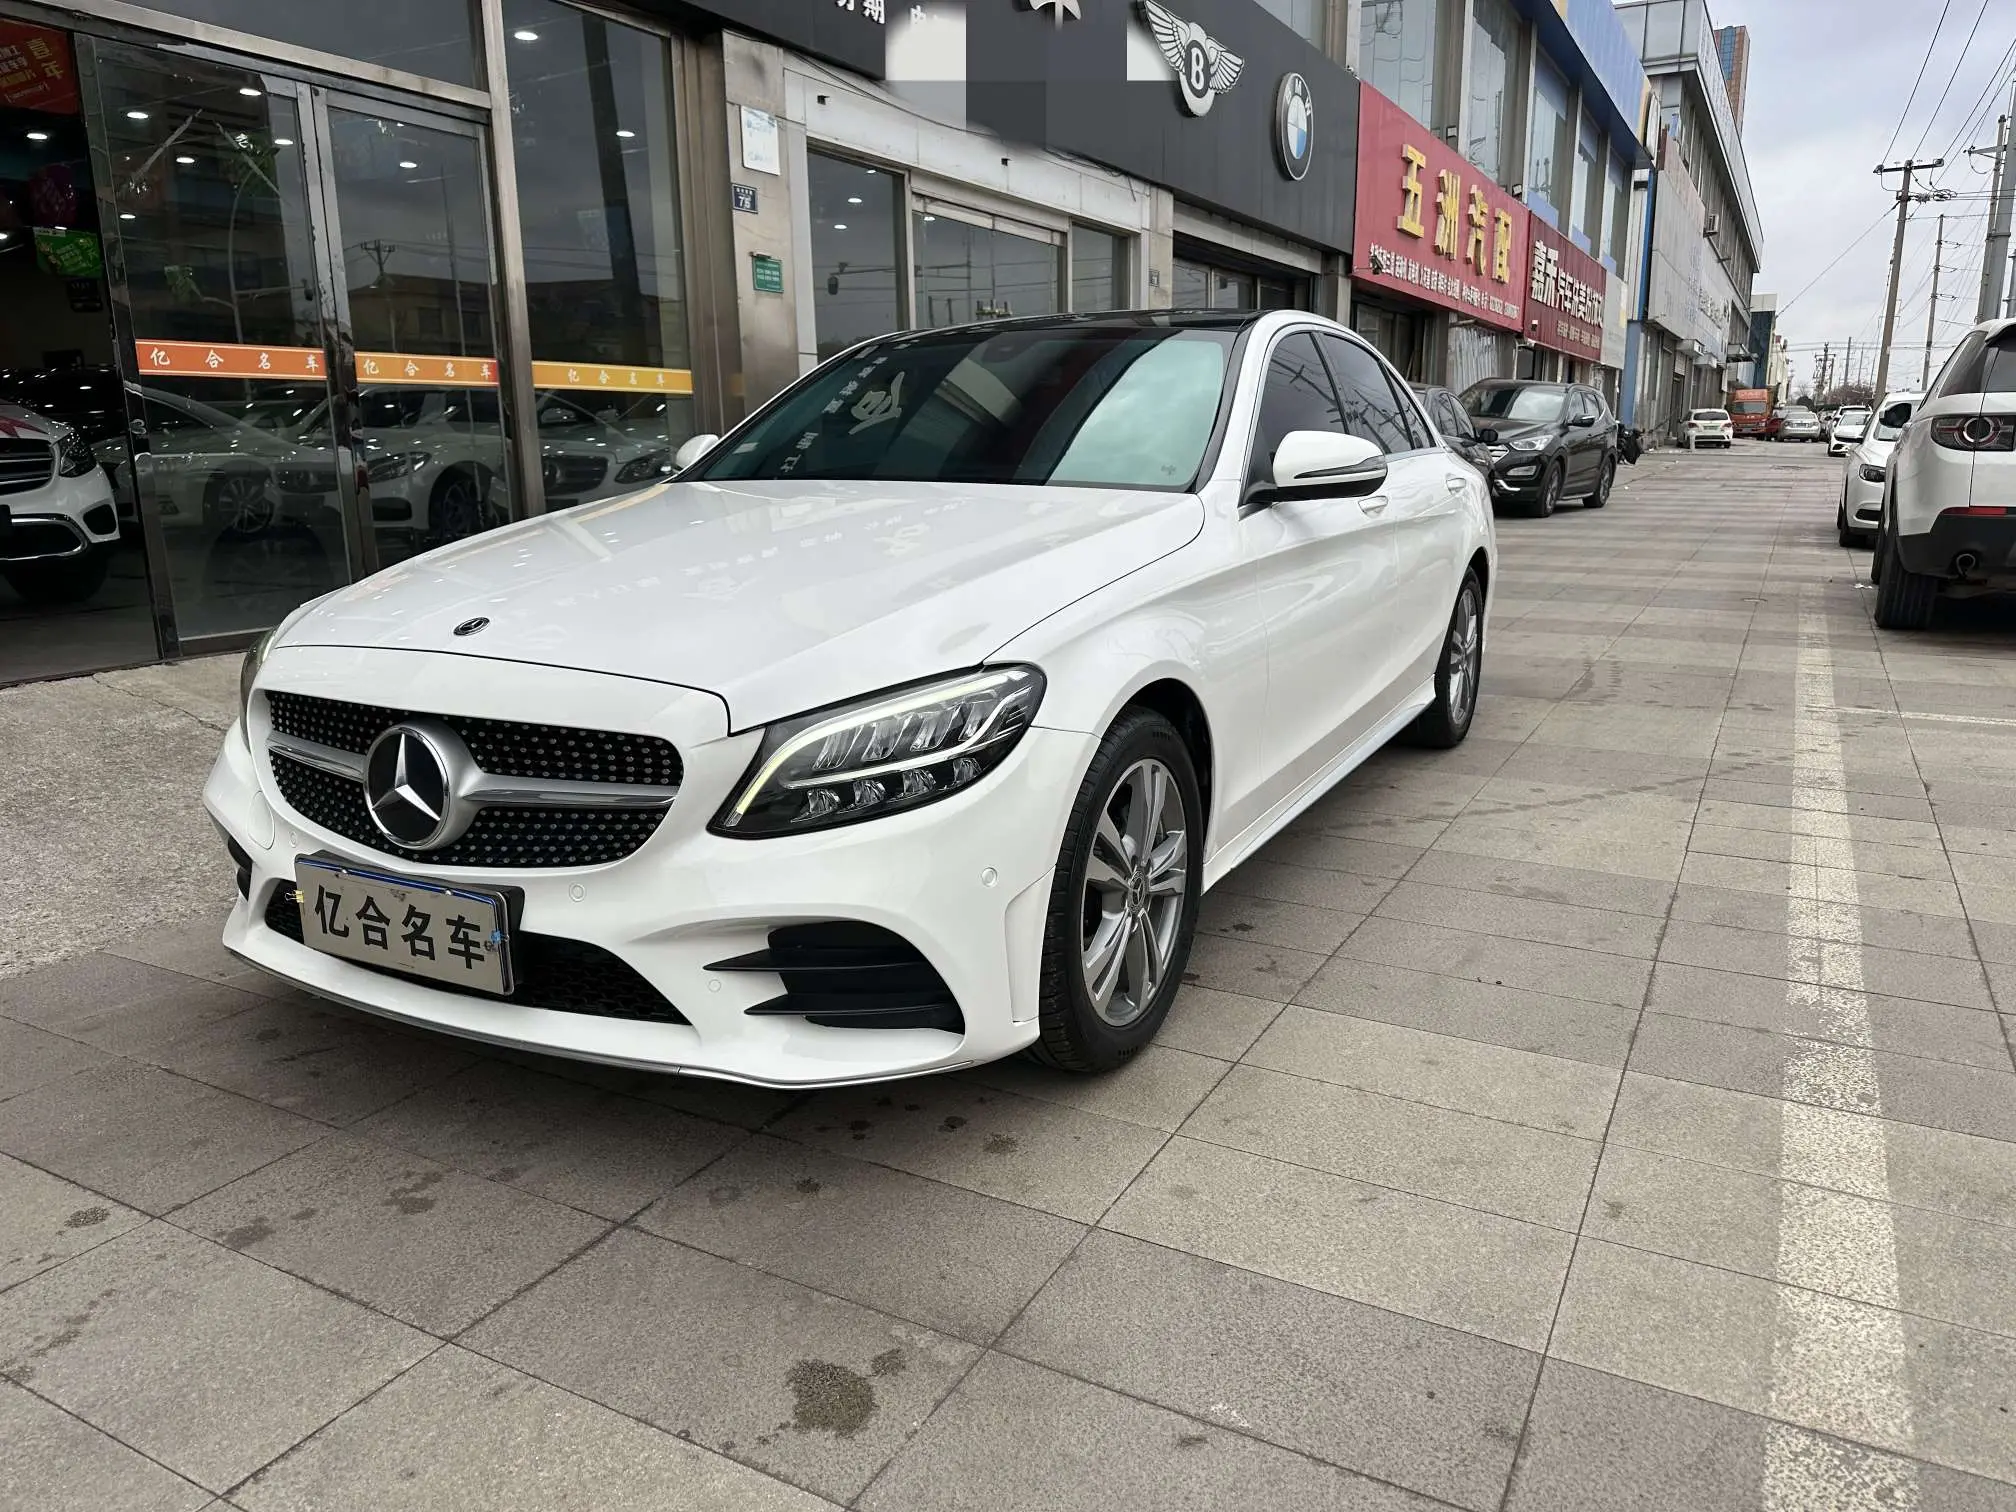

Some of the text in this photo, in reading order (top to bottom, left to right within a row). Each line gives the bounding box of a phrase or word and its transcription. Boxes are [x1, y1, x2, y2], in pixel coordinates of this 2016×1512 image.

[1397, 143, 1512, 285] 五洲汽配
[150, 346, 320, 373] 亿合名车
[363, 358, 492, 381] 亿合名车
[314, 884, 485, 970] 亿合名车
